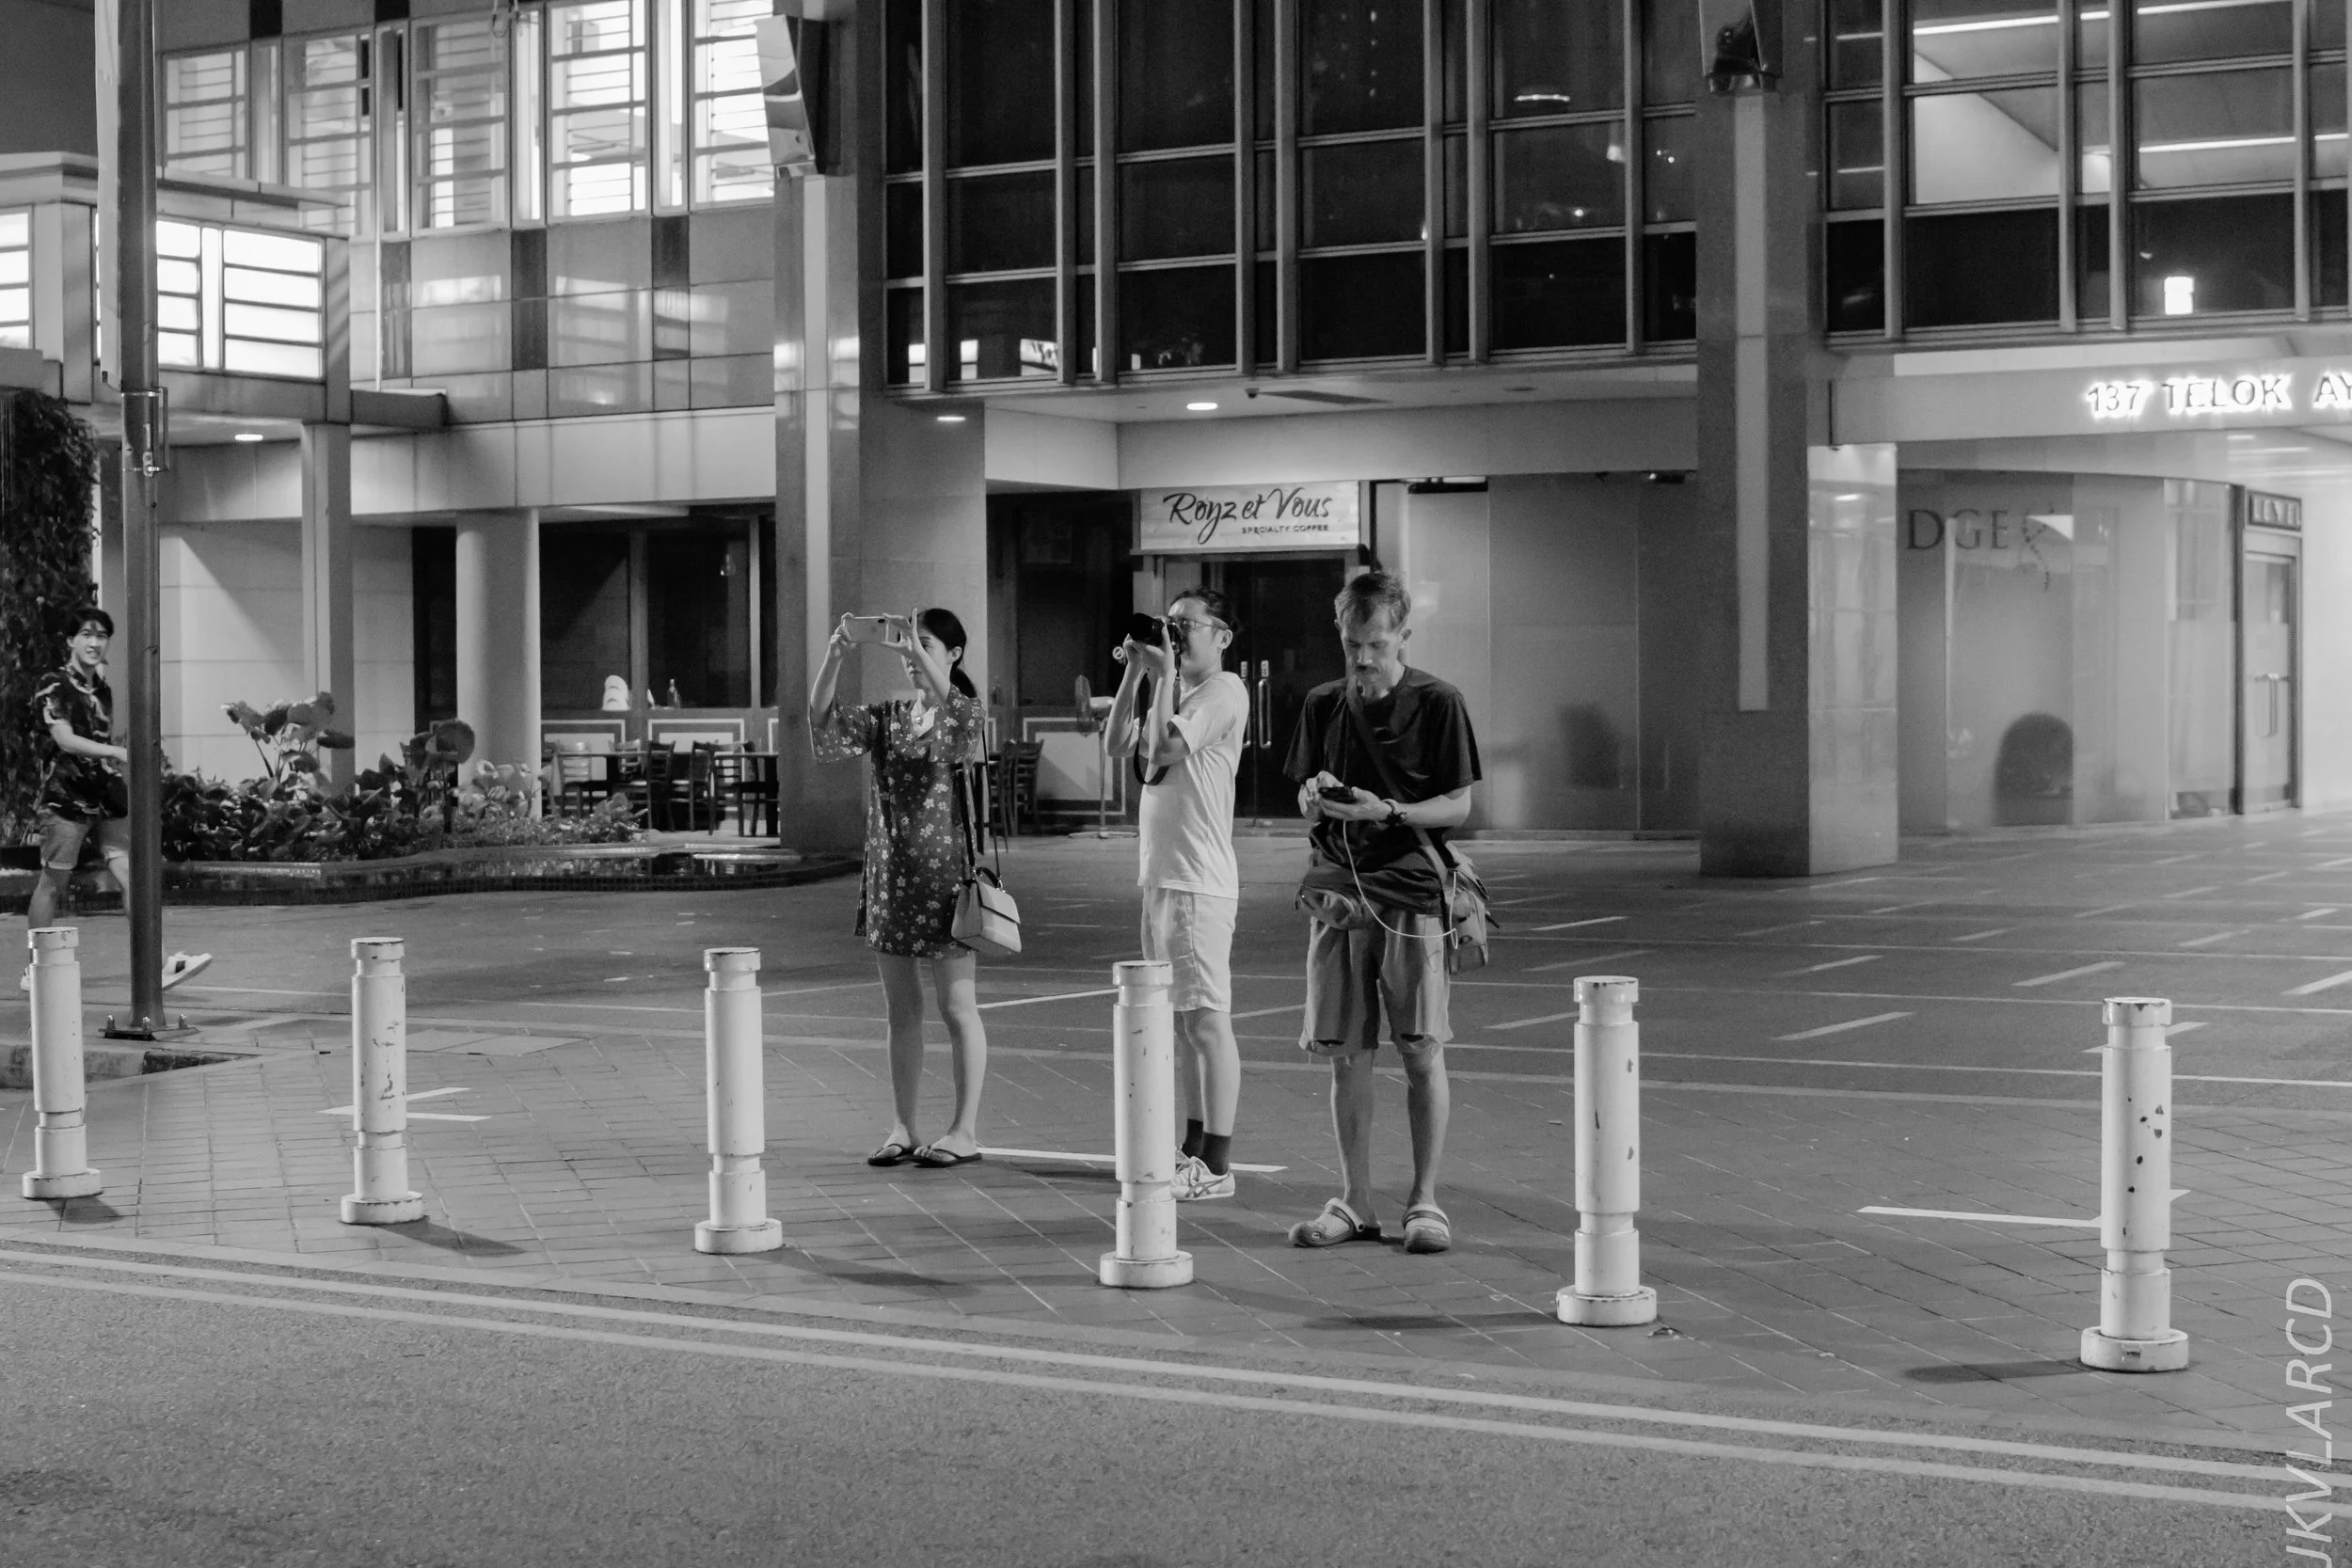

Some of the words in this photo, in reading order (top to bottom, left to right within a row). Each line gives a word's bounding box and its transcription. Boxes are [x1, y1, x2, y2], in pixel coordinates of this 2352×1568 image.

[2085, 379, 2151, 416] 137
[2162, 374, 2293, 414] TELOK
[1162, 492, 1237, 545] Royz
[1241, 493, 1266, 519] et
[1266, 486, 1333, 519] Vous
[1241, 526, 1290, 535] SPECIALTY
[1293, 524, 1329, 533] COFFEE
